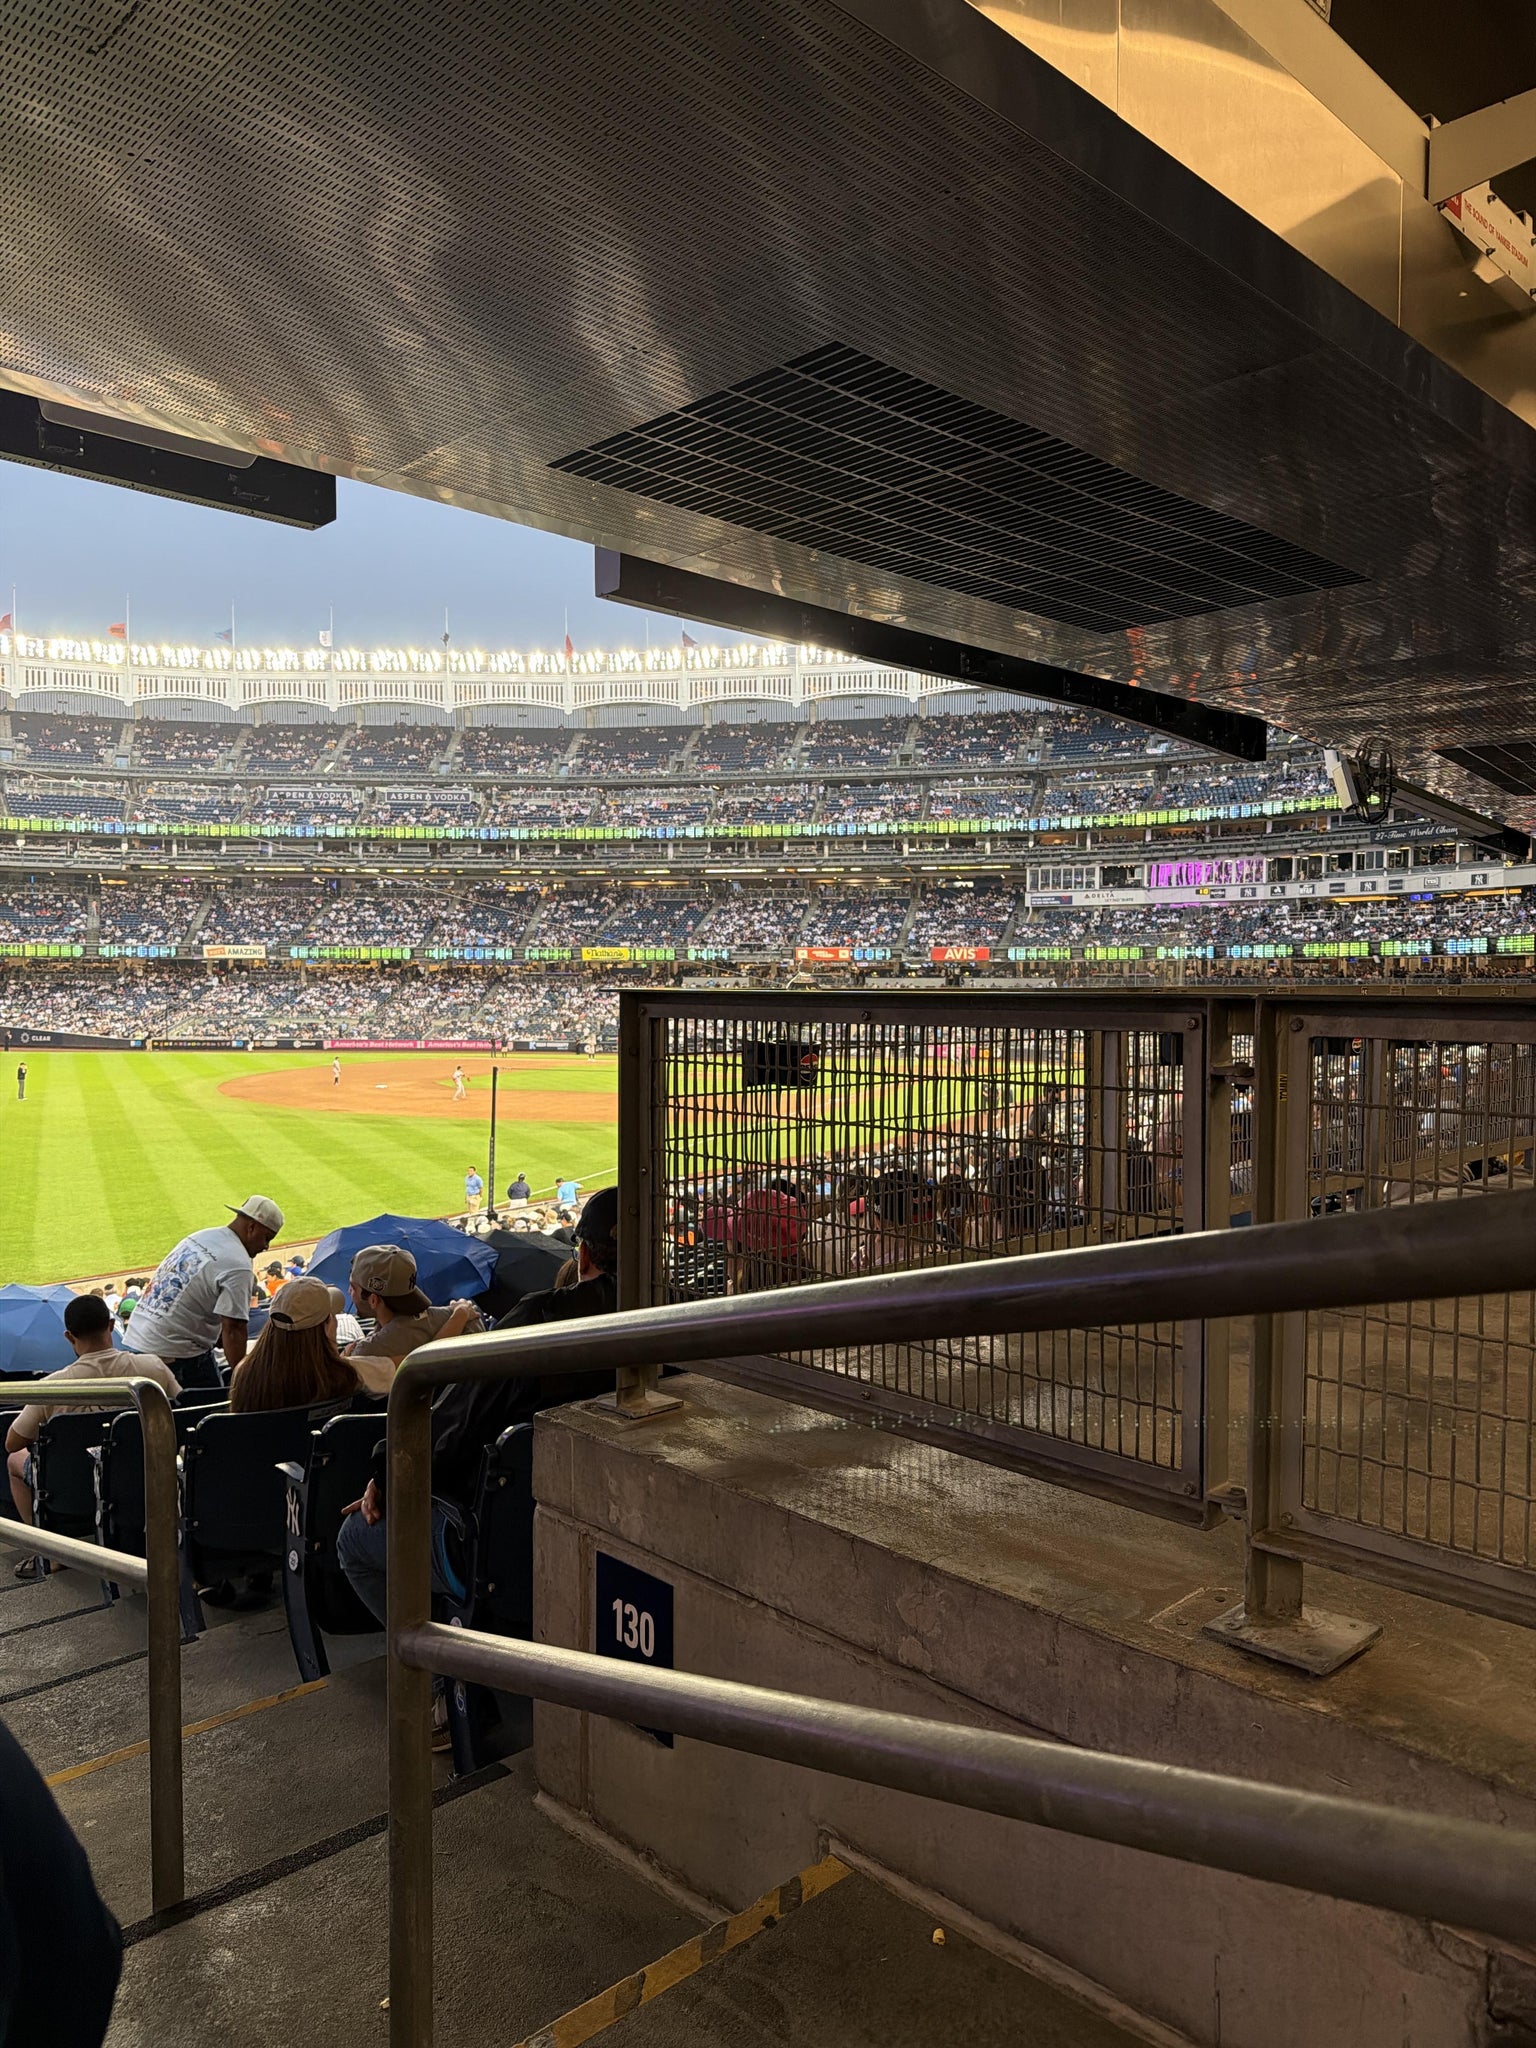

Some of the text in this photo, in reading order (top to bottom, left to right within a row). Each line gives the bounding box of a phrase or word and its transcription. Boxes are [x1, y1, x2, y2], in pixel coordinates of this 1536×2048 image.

[1464, 198, 1472, 215] THE
[1473, 208, 1488, 229] SOUND
[1488, 223, 1495, 235] OF
[1495, 229, 1511, 252] YANKEE
[1511, 244, 1529, 268] STADIUM
[272, 790, 349, 800] APEN VODKA
[391, 792, 466, 801] ASPEN VODKA
[1374, 830, 1407, 841] 27-Time
[1408, 826, 1435, 837] World
[227, 948, 263, 956] AMAZING
[944, 949, 977, 959] AVIS
[612, 1597, 655, 1658] 130
